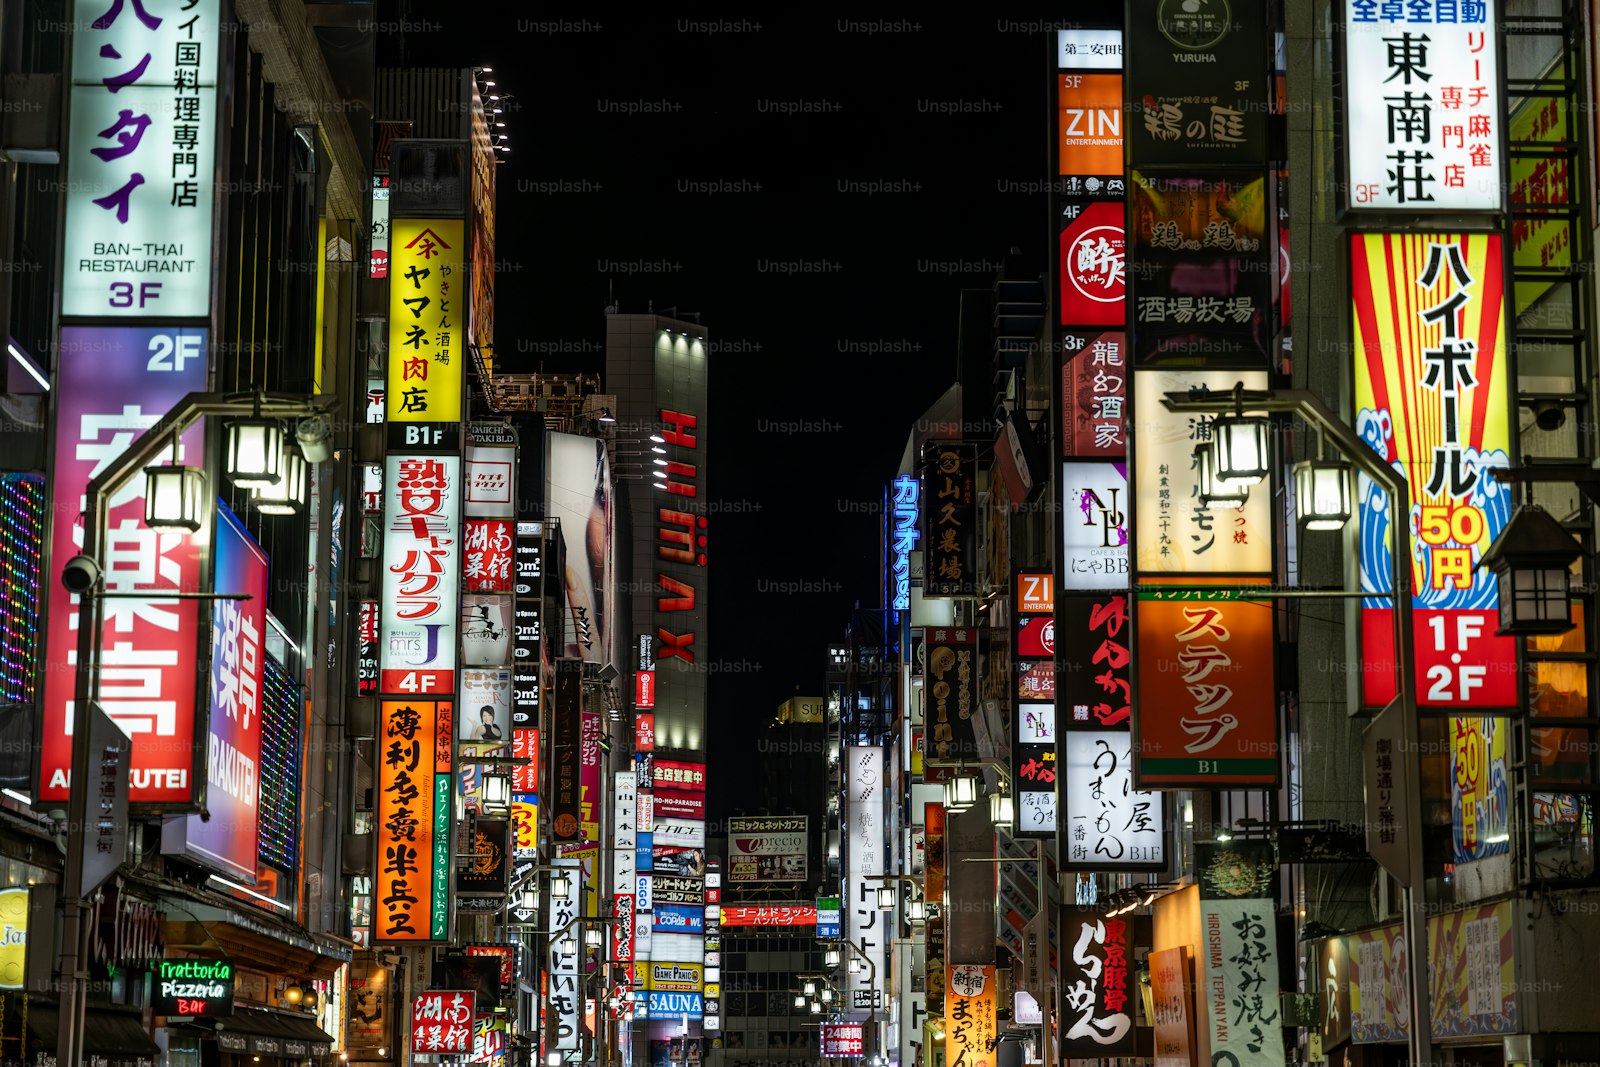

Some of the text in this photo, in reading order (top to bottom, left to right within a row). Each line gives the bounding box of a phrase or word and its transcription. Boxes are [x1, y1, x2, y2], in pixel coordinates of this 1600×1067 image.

[1172, 53, 1217, 63] YURUHA
[1064, 75, 1082, 89] 5F
[1233, 80, 1250, 91] 3F
[1467, 31, 1492, 168] リーチ麻雀
[1066, 109, 1120, 136] ZIN
[1143, 102, 1248, 143] 鶏の庭
[1381, 32, 1436, 204] 東南荘
[1066, 138, 1123, 146] ENTERTAINMENT
[1440, 86, 1466, 188] 専門店
[1355, 185, 1380, 203] 3F
[1063, 205, 1080, 219] 4F
[93, 243, 183, 257] BAN-THAI
[79, 260, 195, 273] RESTAURANT
[109, 282, 163, 308] 3F
[434, 264, 452, 366] やきとん酒場
[1138, 296, 1256, 324] 酒場牧場
[147, 334, 202, 371] 2F
[398, 265, 431, 415] ヤマネ肉店
[1064, 335, 1085, 350] 3F
[1416, 242, 1480, 500] ハイボール
[1091, 341, 1125, 448] 龍幻酒家
[496, 435, 514, 443] BLD
[1158, 463, 1172, 558] 創業昭和二十九年
[464, 523, 513, 551] 湖南
[1420, 505, 1484, 546] 50
[464, 552, 512, 580] 菜館
[478, 580, 496, 589] 4F
[935, 629, 967, 641] 麻雀
[1019, 618, 1029, 626] 4F
[1428, 615, 1485, 651] 1F
[1020, 662, 1032, 671] 3F
[399, 672, 437, 693] 4F
[957, 650, 971, 720] MAHJONG
[1175, 606, 1239, 754] ステップ
[1426, 665, 1487, 701] 2F
[436, 707, 451, 764] 炭火串焼
[653, 766, 703, 784] 全店営業中
[1198, 760, 1219, 774] B1
[1089, 739, 1124, 860] うまいもん
[731, 819, 806, 830] コミック&ネットカフェ
[1072, 815, 1089, 861] 一番街
[1129, 846, 1161, 861] B1F
[638, 877, 648, 907] GiGO
[753, 917, 795, 925] ハンバーグ
[1207, 912, 1222, 969] HIROSHIMA
[159, 961, 229, 979] Trattoria
[1103, 919, 1128, 1012] 東京豚骨
[162, 980, 225, 998] Pizzeria
[1229, 911, 1278, 1053] お好み焼き
[178, 999, 206, 1014] Bar
[415, 992, 471, 1025] 湖南
[649, 993, 703, 1012] SAUNA
[426, 1026, 470, 1052] 菜館
[826, 1028, 862, 1039] 24時間
